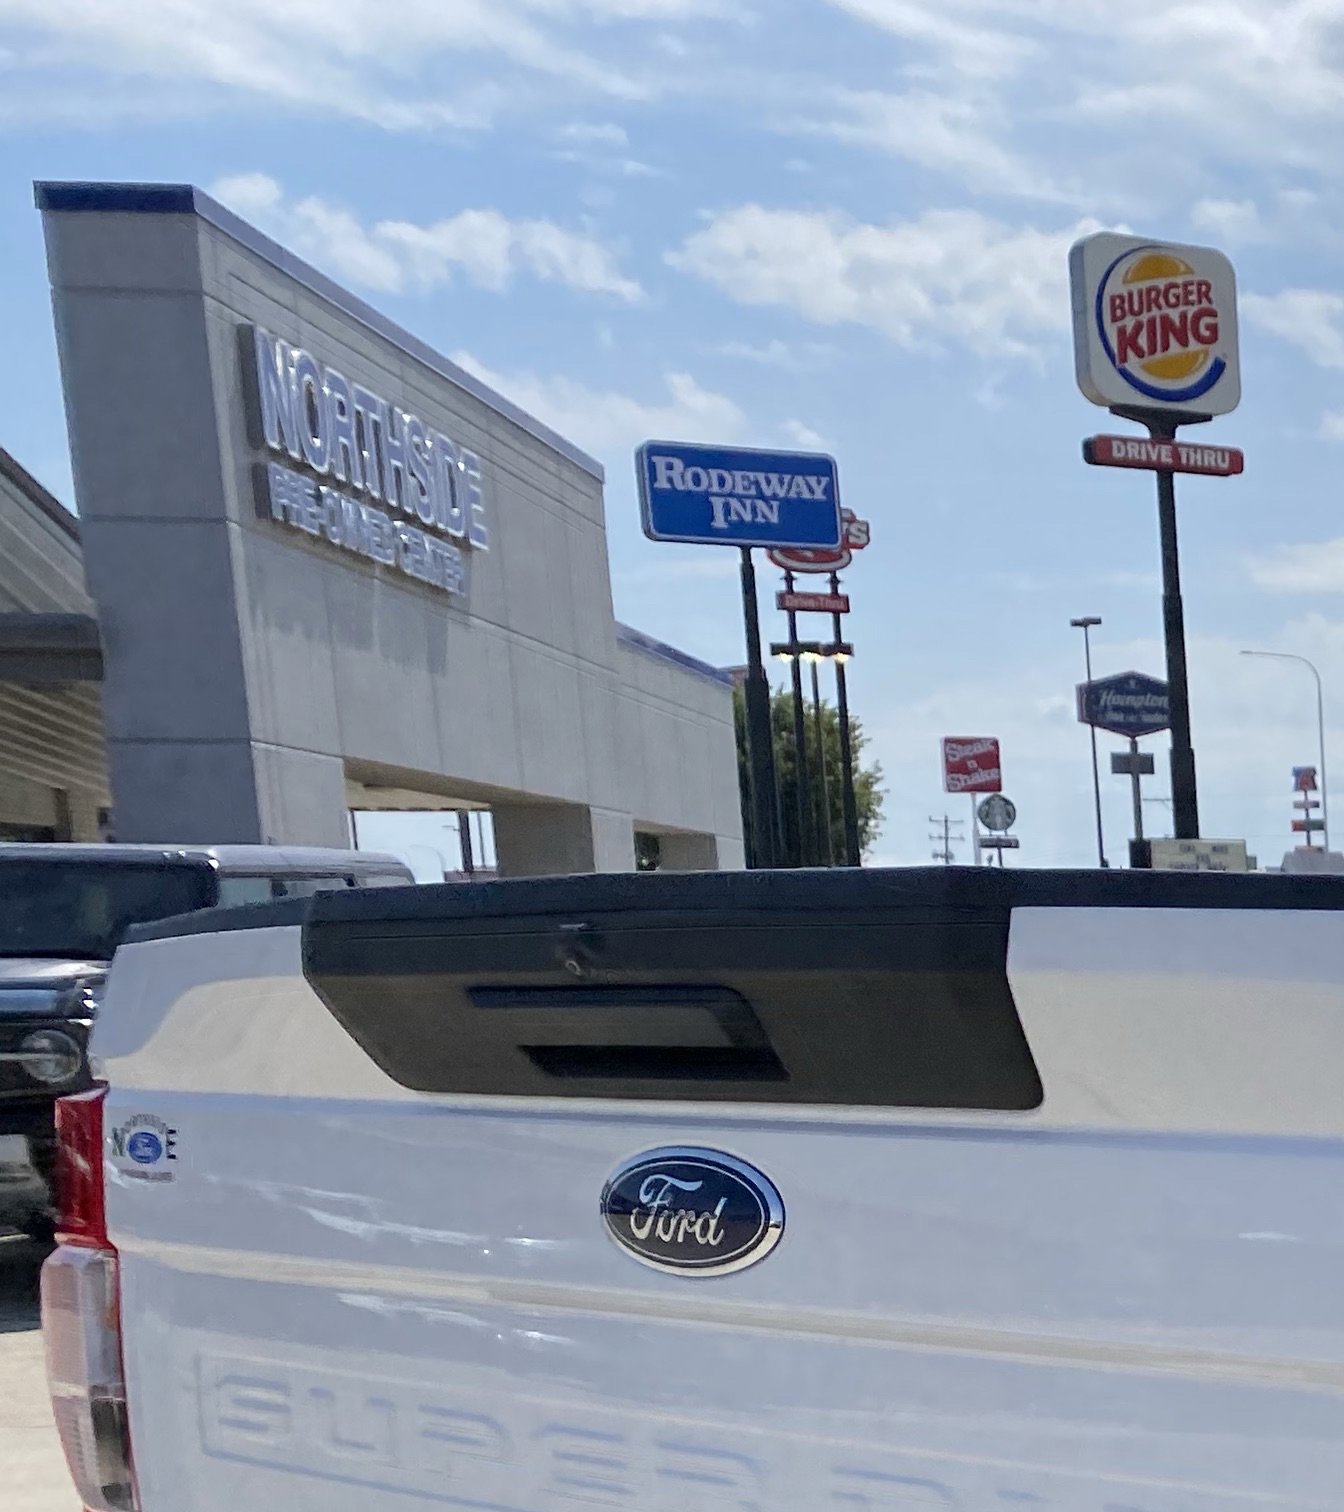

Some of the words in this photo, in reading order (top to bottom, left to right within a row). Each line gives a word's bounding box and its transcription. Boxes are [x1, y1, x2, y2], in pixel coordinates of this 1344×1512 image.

[1109, 279, 1214, 323] BURGER
[1116, 306, 1219, 365] KING
[254, 325, 489, 551] NORTHSIDE
[1111, 439, 1173, 465] DRIVE
[1178, 446, 1231, 469] THRU
[650, 455, 830, 500] RODEWAY
[708, 496, 780, 529] INN
[630, 1173, 729, 1246] Ford
